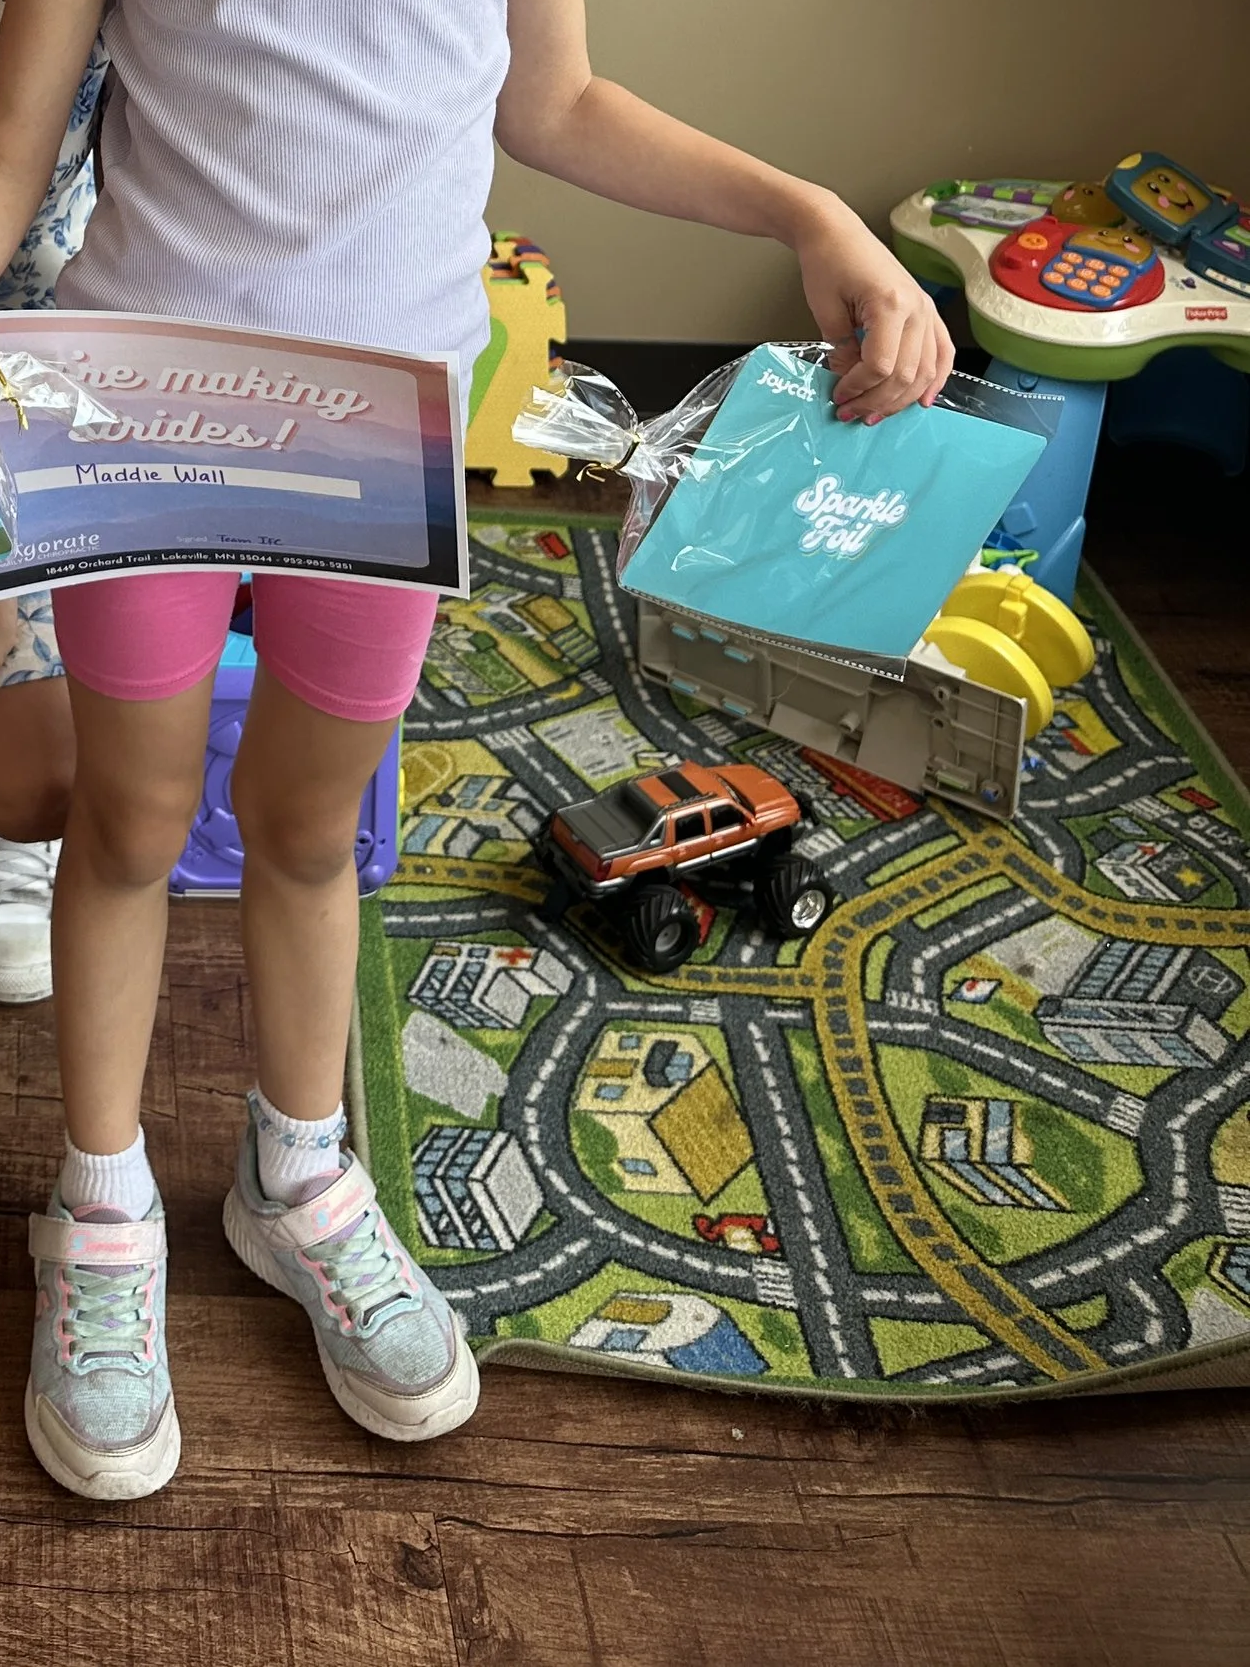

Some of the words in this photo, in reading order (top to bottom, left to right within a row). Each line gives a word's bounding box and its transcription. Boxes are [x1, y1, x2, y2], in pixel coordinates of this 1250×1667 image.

[158, 365, 373, 421] making
[75, 463, 162, 485] Maddie
[173, 465, 225, 485] Wall
[795, 475, 906, 524] Sparkle
[217, 534, 251, 544] Team
[801, 515, 873, 553] Foil
[37, 545, 100, 560] CHIROPRACTIC
[46, 563, 75, 576] 18449
[78, 556, 123, 569] Orchard
[126, 553, 151, 564] Trail
[161, 552, 212, 562] Lakeville,
[239, 553, 273, 563] 55044
[283, 556, 352, 570] 952-985-5251
